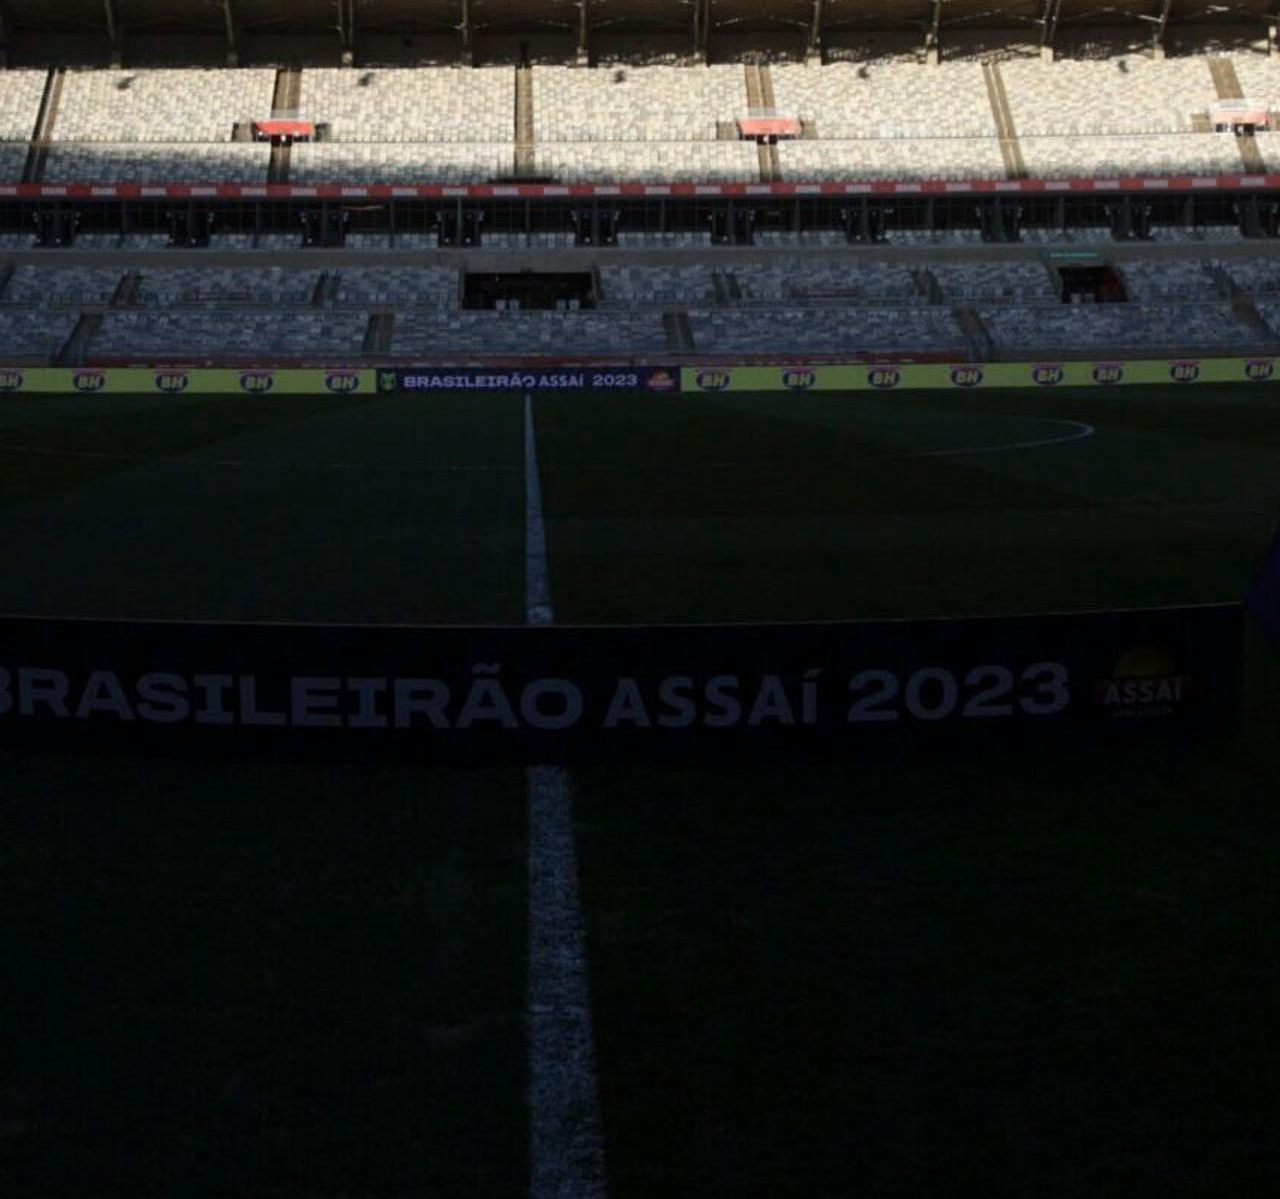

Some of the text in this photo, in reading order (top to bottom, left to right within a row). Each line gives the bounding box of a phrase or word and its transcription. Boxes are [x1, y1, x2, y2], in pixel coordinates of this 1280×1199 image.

[403, 372, 535, 388] BRASILEIRÃO
[539, 374, 584, 388] ASSAÍ
[592, 374, 638, 388] 2023
[788, 372, 810, 386] BH
[872, 372, 895, 385] BH
[957, 370, 978, 384] BH
[1039, 368, 1059, 383] BH
[1099, 368, 1118, 382] BH
[1175, 366, 1195, 380] BH
[79, 374, 100, 388] BH
[162, 375, 184, 389] BH
[246, 375, 268, 389] BH
[331, 375, 354, 389] BH
[701, 374, 724, 388] BH
[602, 667, 822, 729] ASSAÍ
[846, 661, 1071, 723] 2023
